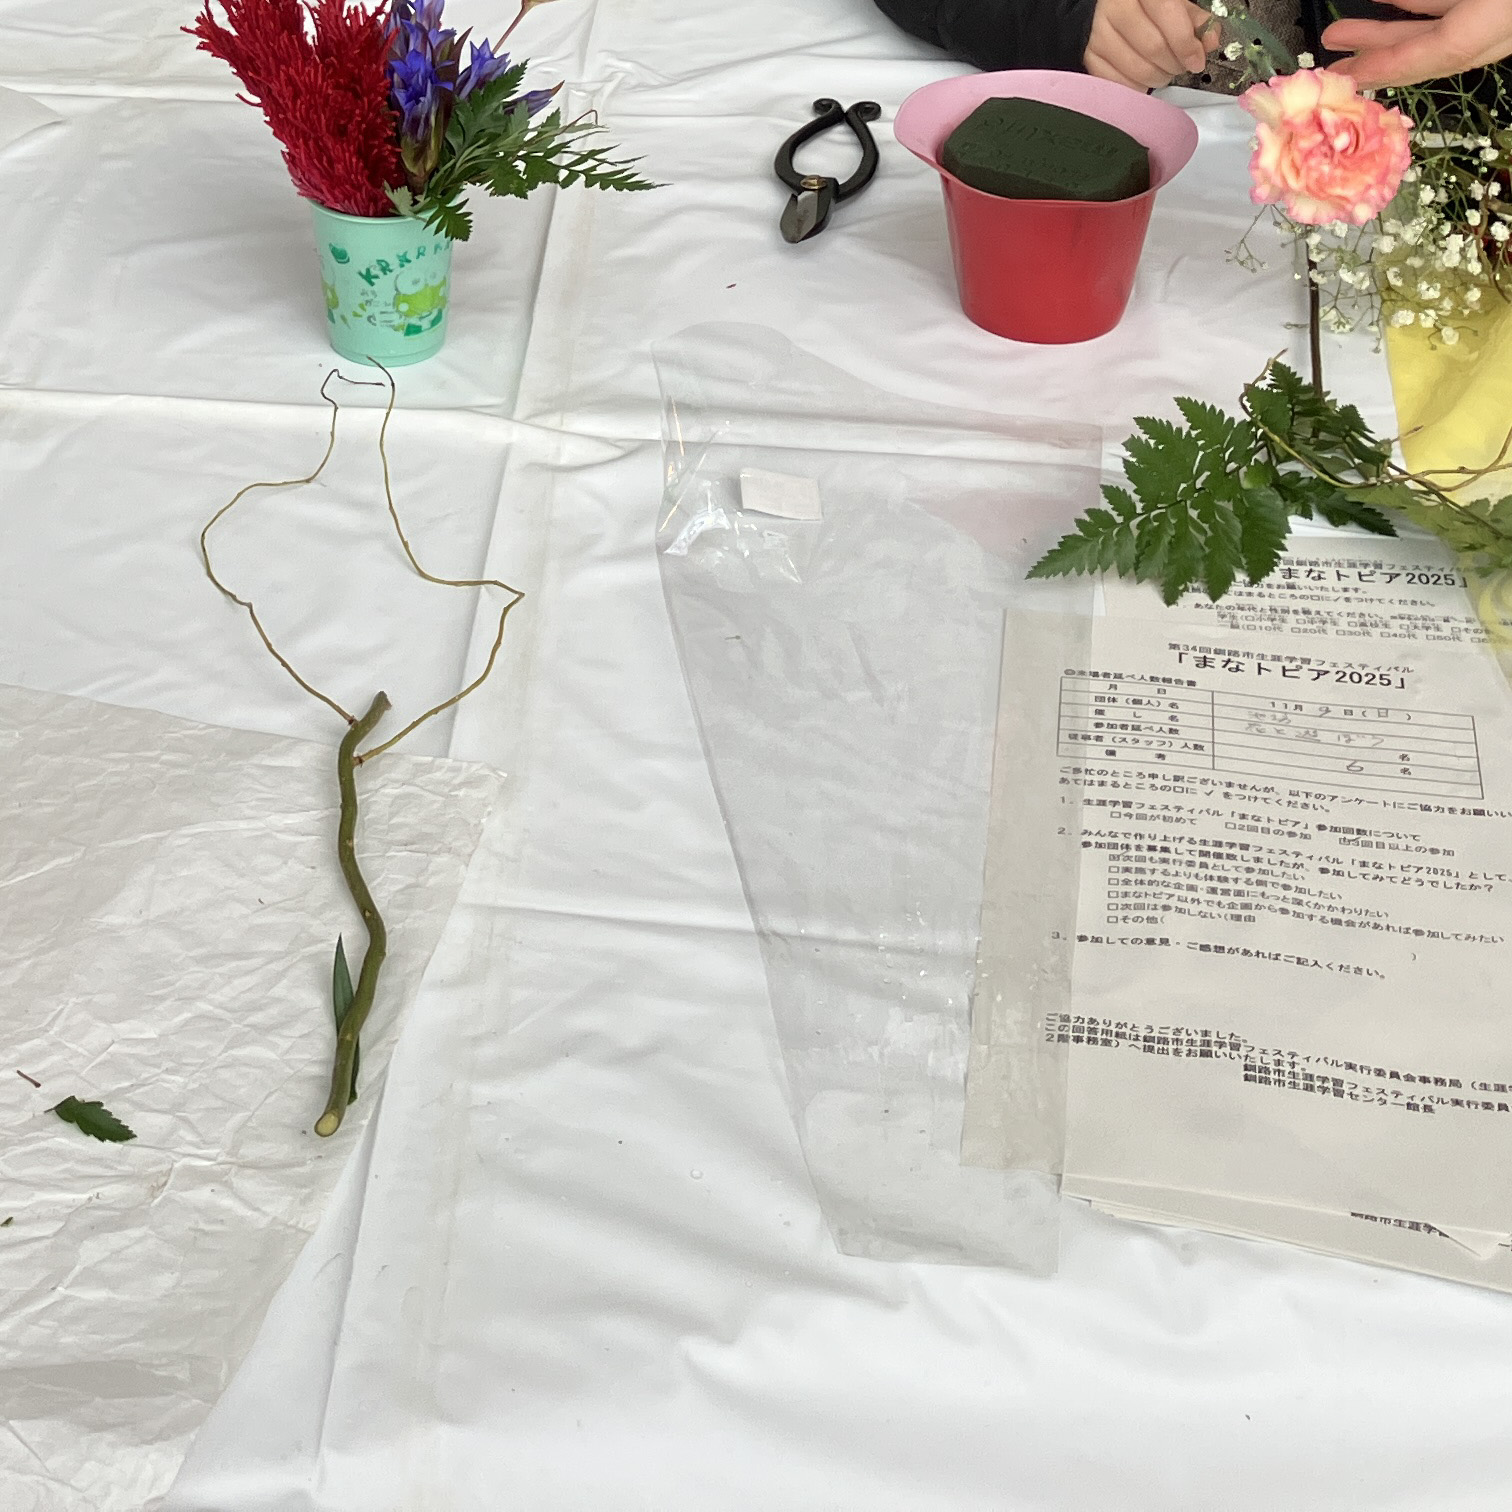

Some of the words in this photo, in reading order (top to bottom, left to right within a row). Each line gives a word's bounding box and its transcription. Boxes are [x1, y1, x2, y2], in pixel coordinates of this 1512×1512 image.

[1177, 651, 1406, 689] 「まなトピア2025」
